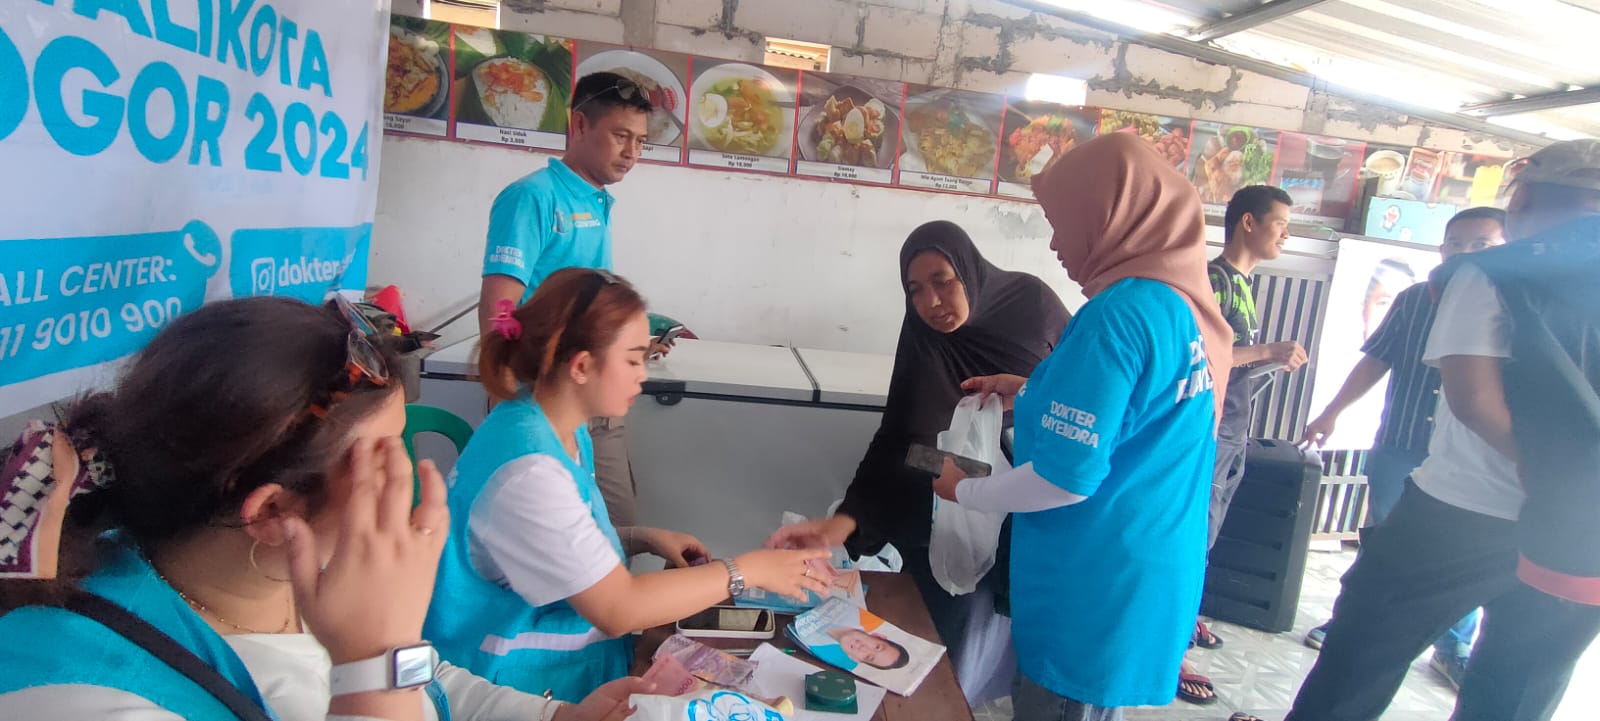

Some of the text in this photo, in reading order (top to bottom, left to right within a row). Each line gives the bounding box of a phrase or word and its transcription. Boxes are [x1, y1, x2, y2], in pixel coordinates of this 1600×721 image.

[36, 0, 332, 97] ALIKOTA
[0, 26, 369, 182] GOR 2024
[0, 255, 177, 307] ALL CENTER:
[278, 254, 348, 288] dokter
[32, 307, 111, 350] 9010
[1041, 413, 1099, 449] RAYENDRA
[1050, 400, 1096, 429] DOKTER
